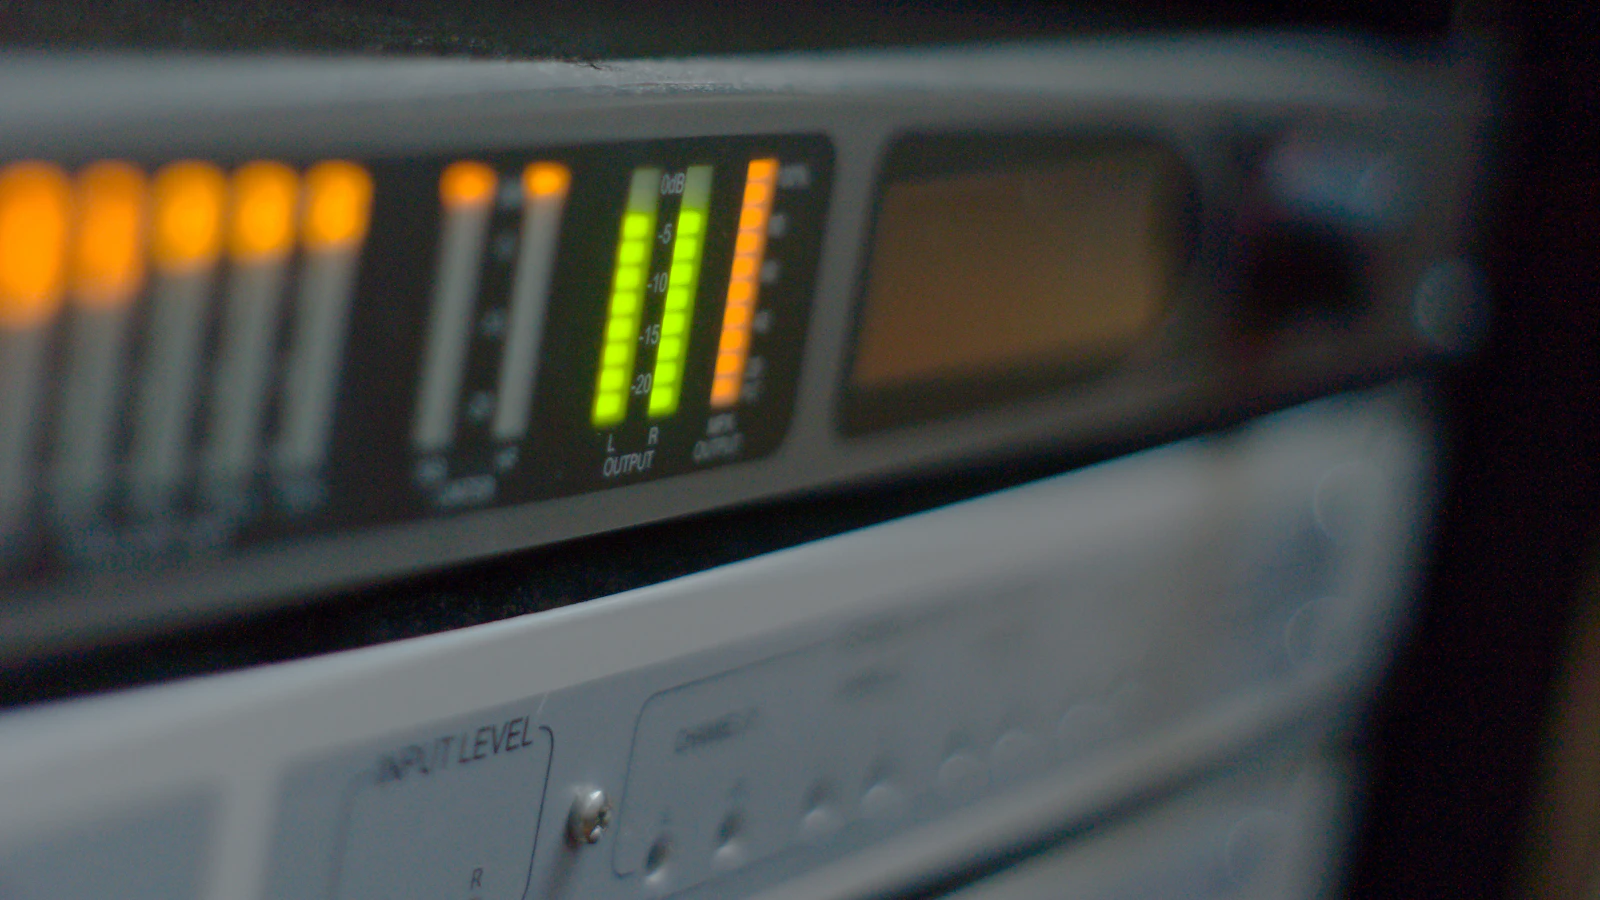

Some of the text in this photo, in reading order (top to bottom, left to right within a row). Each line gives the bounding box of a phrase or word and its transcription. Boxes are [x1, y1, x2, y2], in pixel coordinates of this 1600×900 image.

[660, 172, 685, 195] 0dB
[658, 223, 672, 244] -5
[647, 272, 668, 293] -10
[638, 324, 660, 345] -15
[630, 373, 651, 395] -20
[607, 434, 615, 452] L
[648, 426, 659, 446] R
[603, 450, 655, 477] OUTPUT
[458, 715, 533, 764] LEVEL
[470, 867, 483, 889] R
